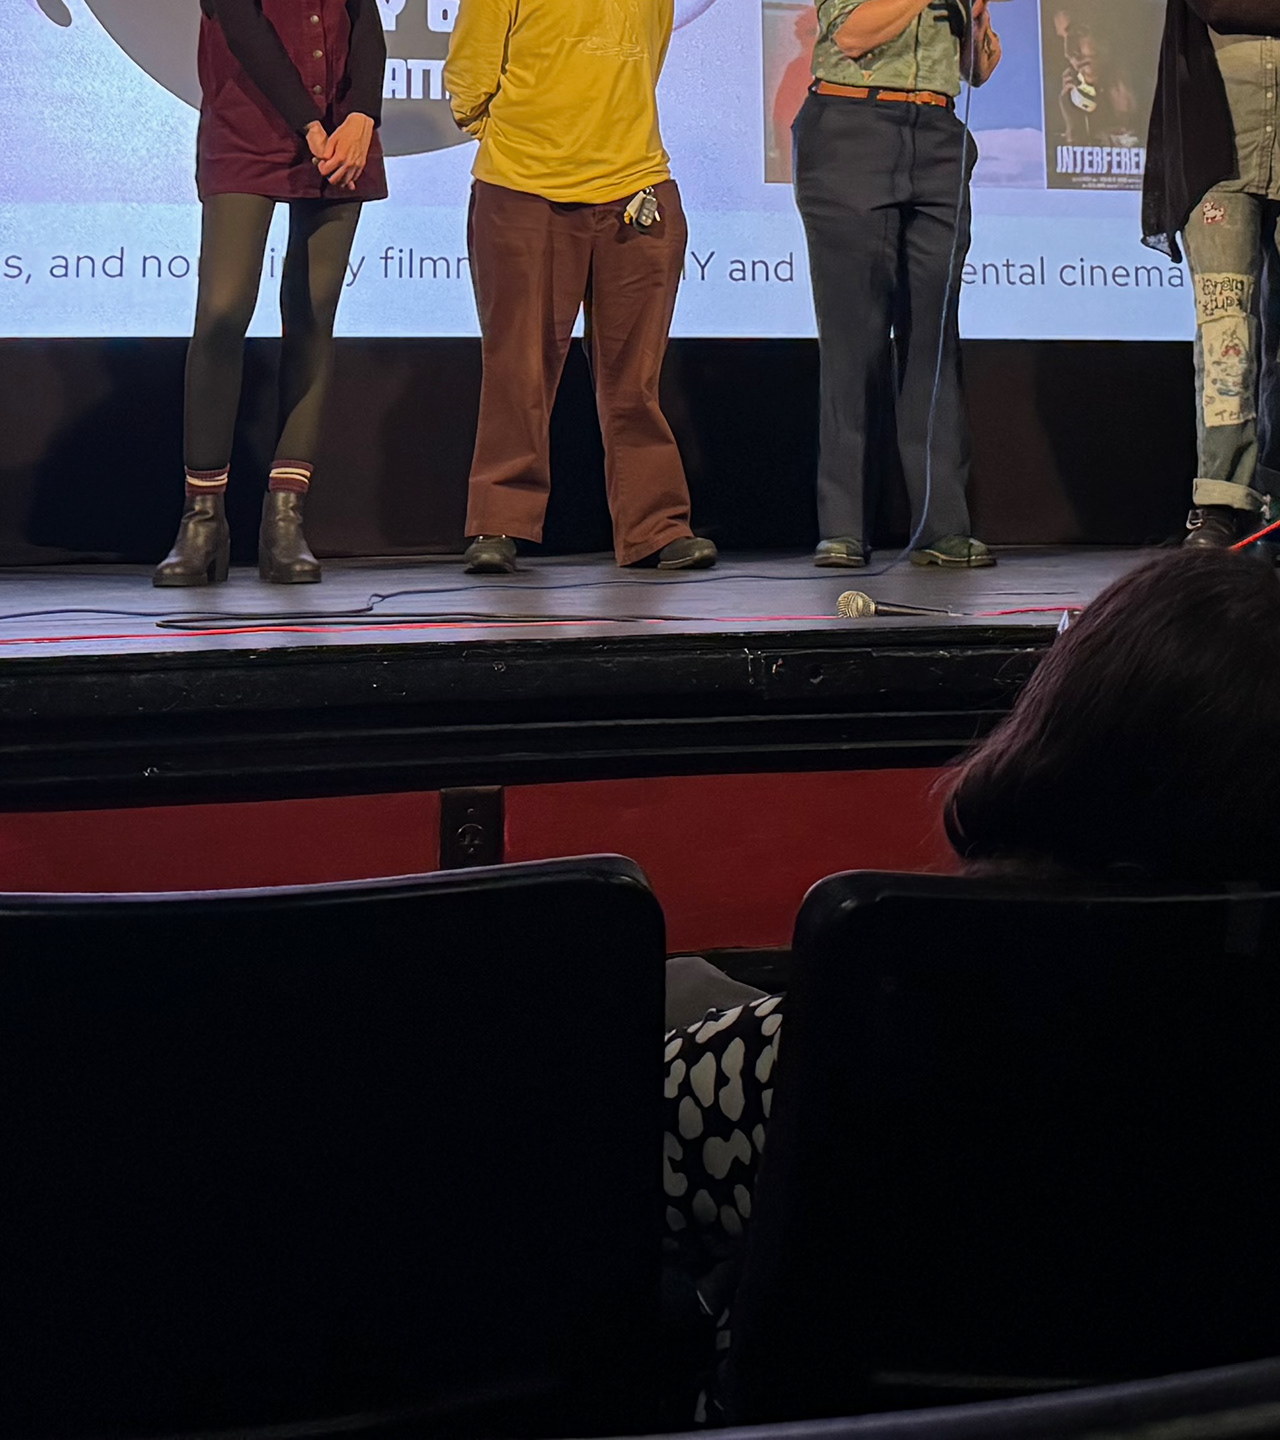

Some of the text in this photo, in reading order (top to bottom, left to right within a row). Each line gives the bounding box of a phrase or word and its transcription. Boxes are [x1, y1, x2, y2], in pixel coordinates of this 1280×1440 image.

[49, 246, 125, 279] and
[728, 251, 794, 282] and
[1059, 257, 1185, 288] cinema
